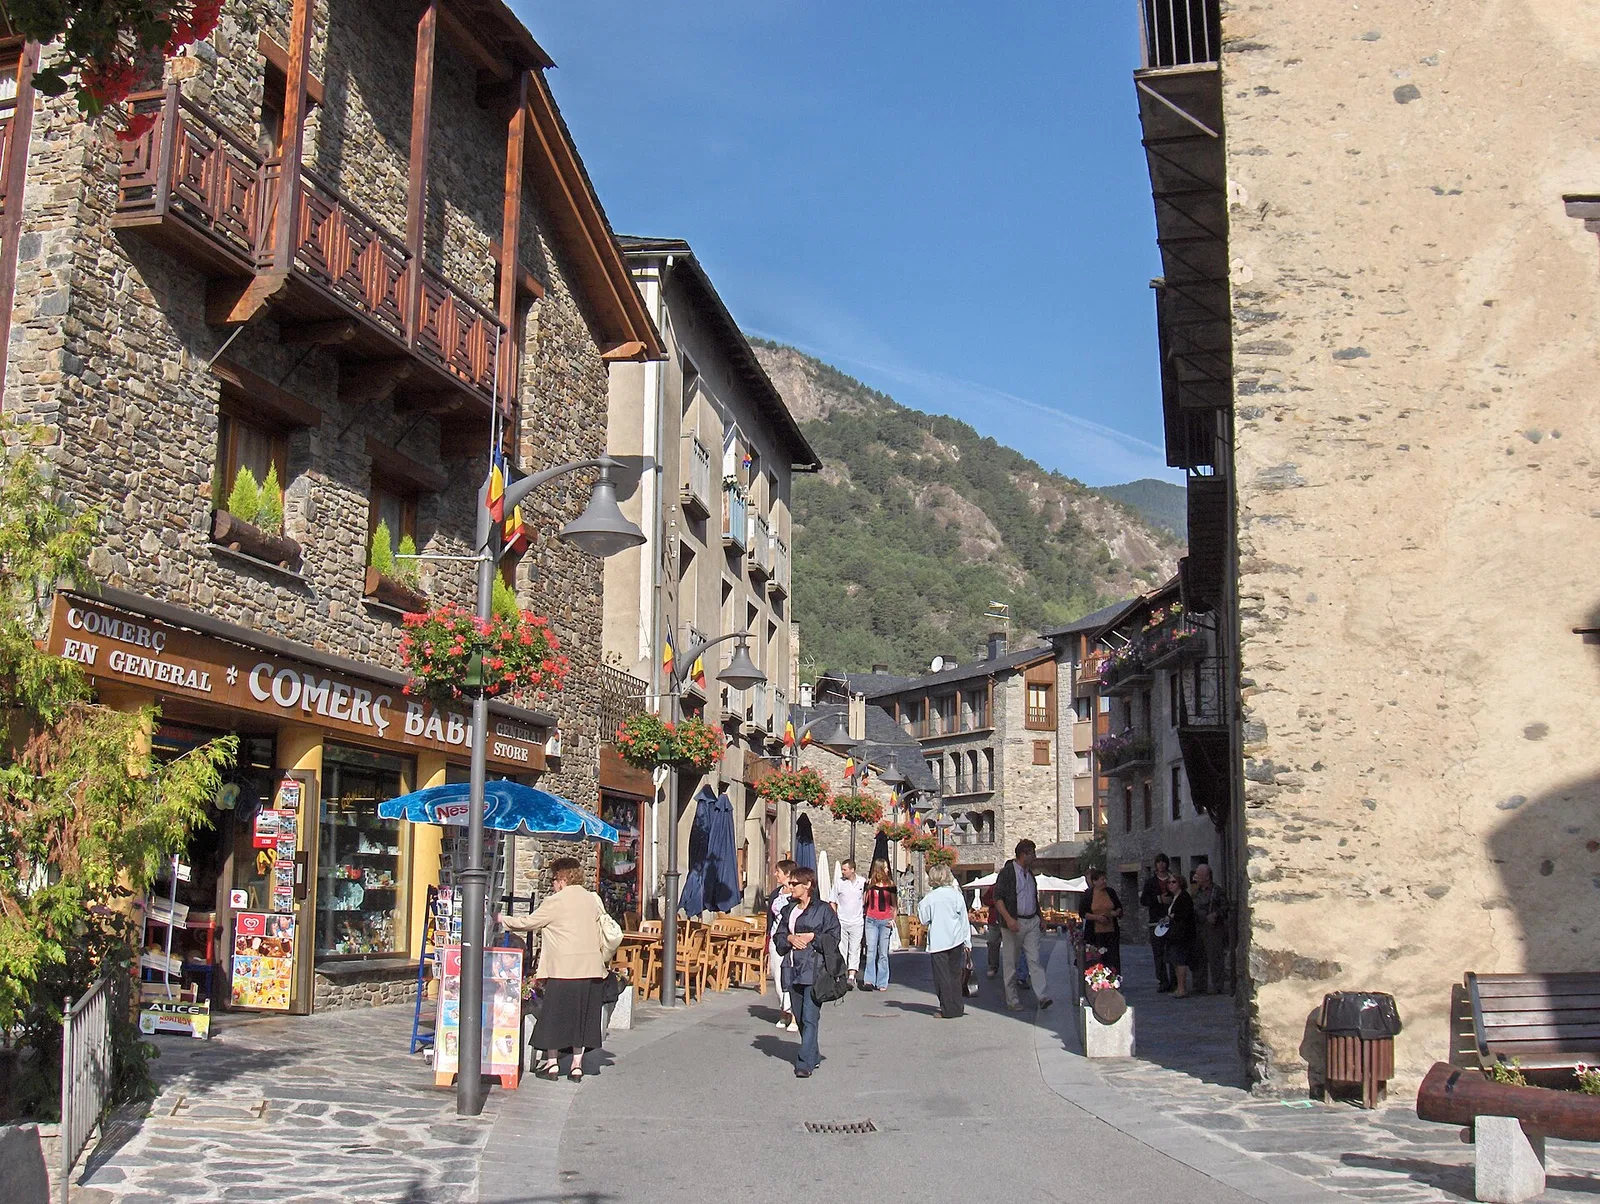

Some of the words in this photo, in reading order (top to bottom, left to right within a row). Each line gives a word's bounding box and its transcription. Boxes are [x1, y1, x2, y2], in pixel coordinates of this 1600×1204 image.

[67, 608, 167, 655] COMERÇ
[62, 638, 98, 665] EN
[109, 650, 212, 693] GENERAL
[249, 662, 392, 737] COMERÇ
[496, 722, 543, 746] GENERAL
[493, 742, 528, 762] STORE
[149, 1003, 199, 1015] ALICE
